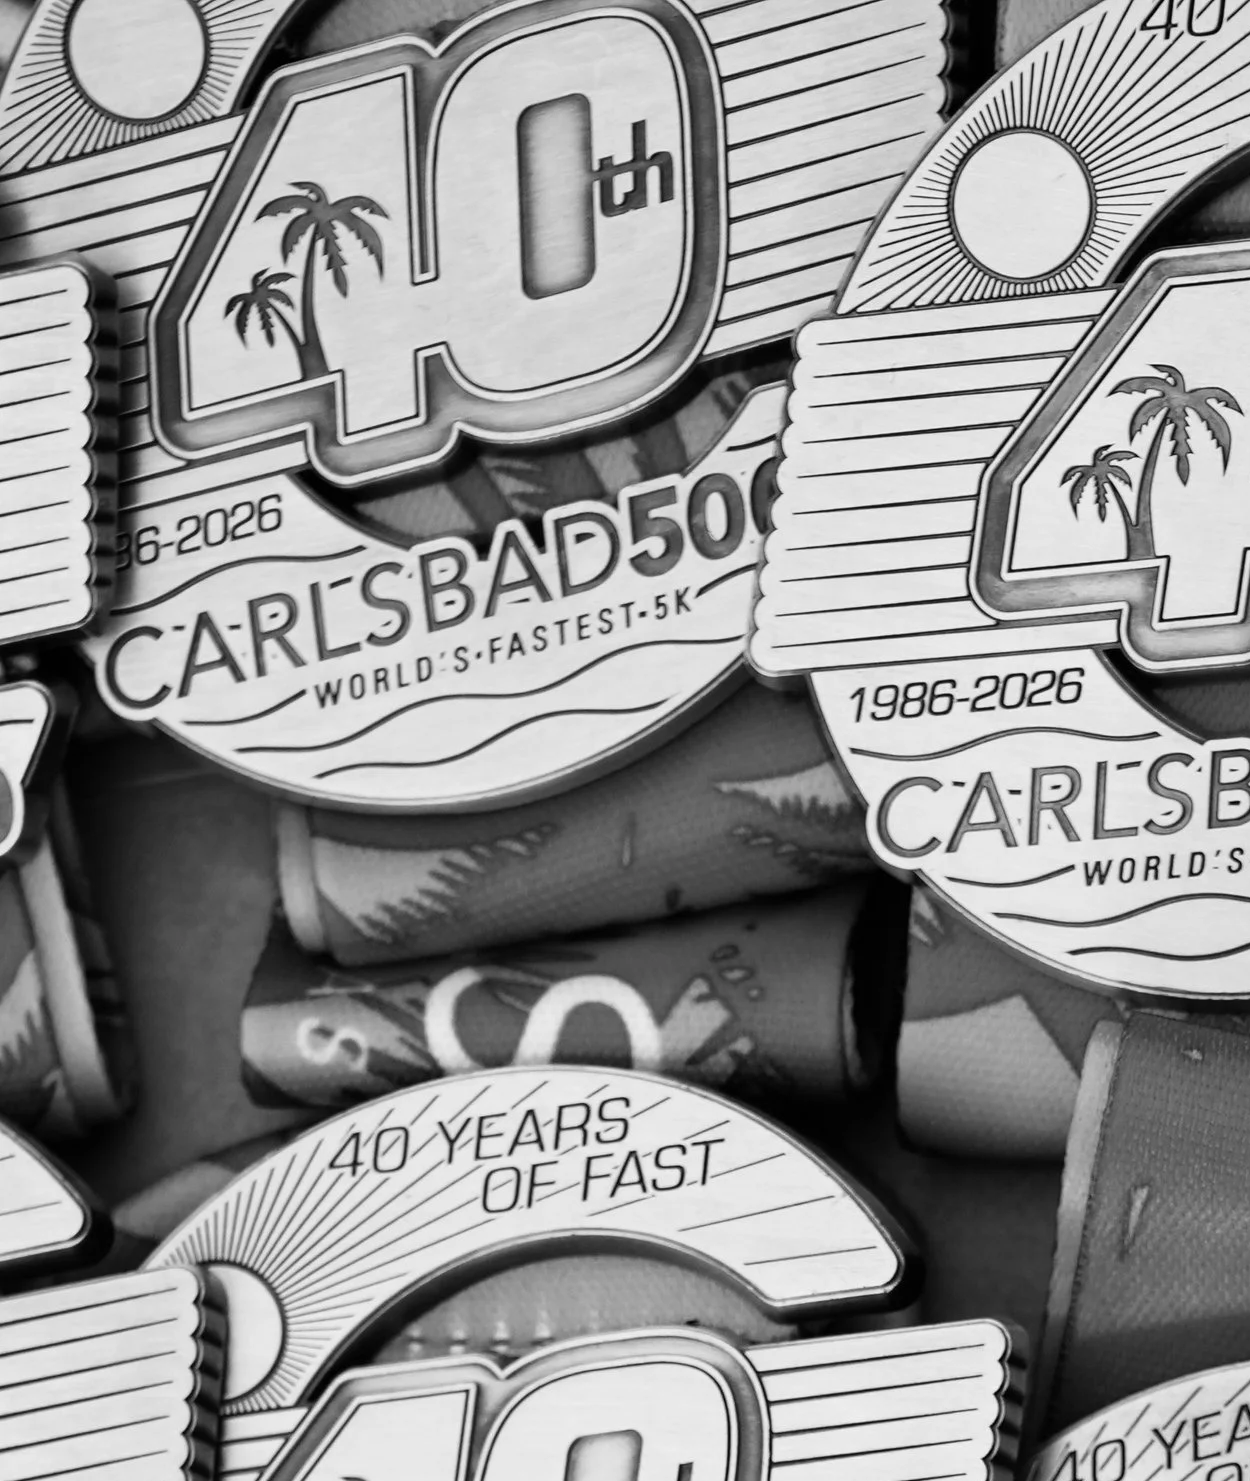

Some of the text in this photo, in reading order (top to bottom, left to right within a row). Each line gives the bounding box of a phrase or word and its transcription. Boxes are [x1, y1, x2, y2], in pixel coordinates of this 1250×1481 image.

[115, 494, 282, 572] 86-2026
[105, 457, 779, 710] CARLSBAD50
[849, 667, 1085, 724] 1986-2026
[328, 1097, 630, 1177] 40 YEARS
[481, 1139, 724, 1214] OF FAST
